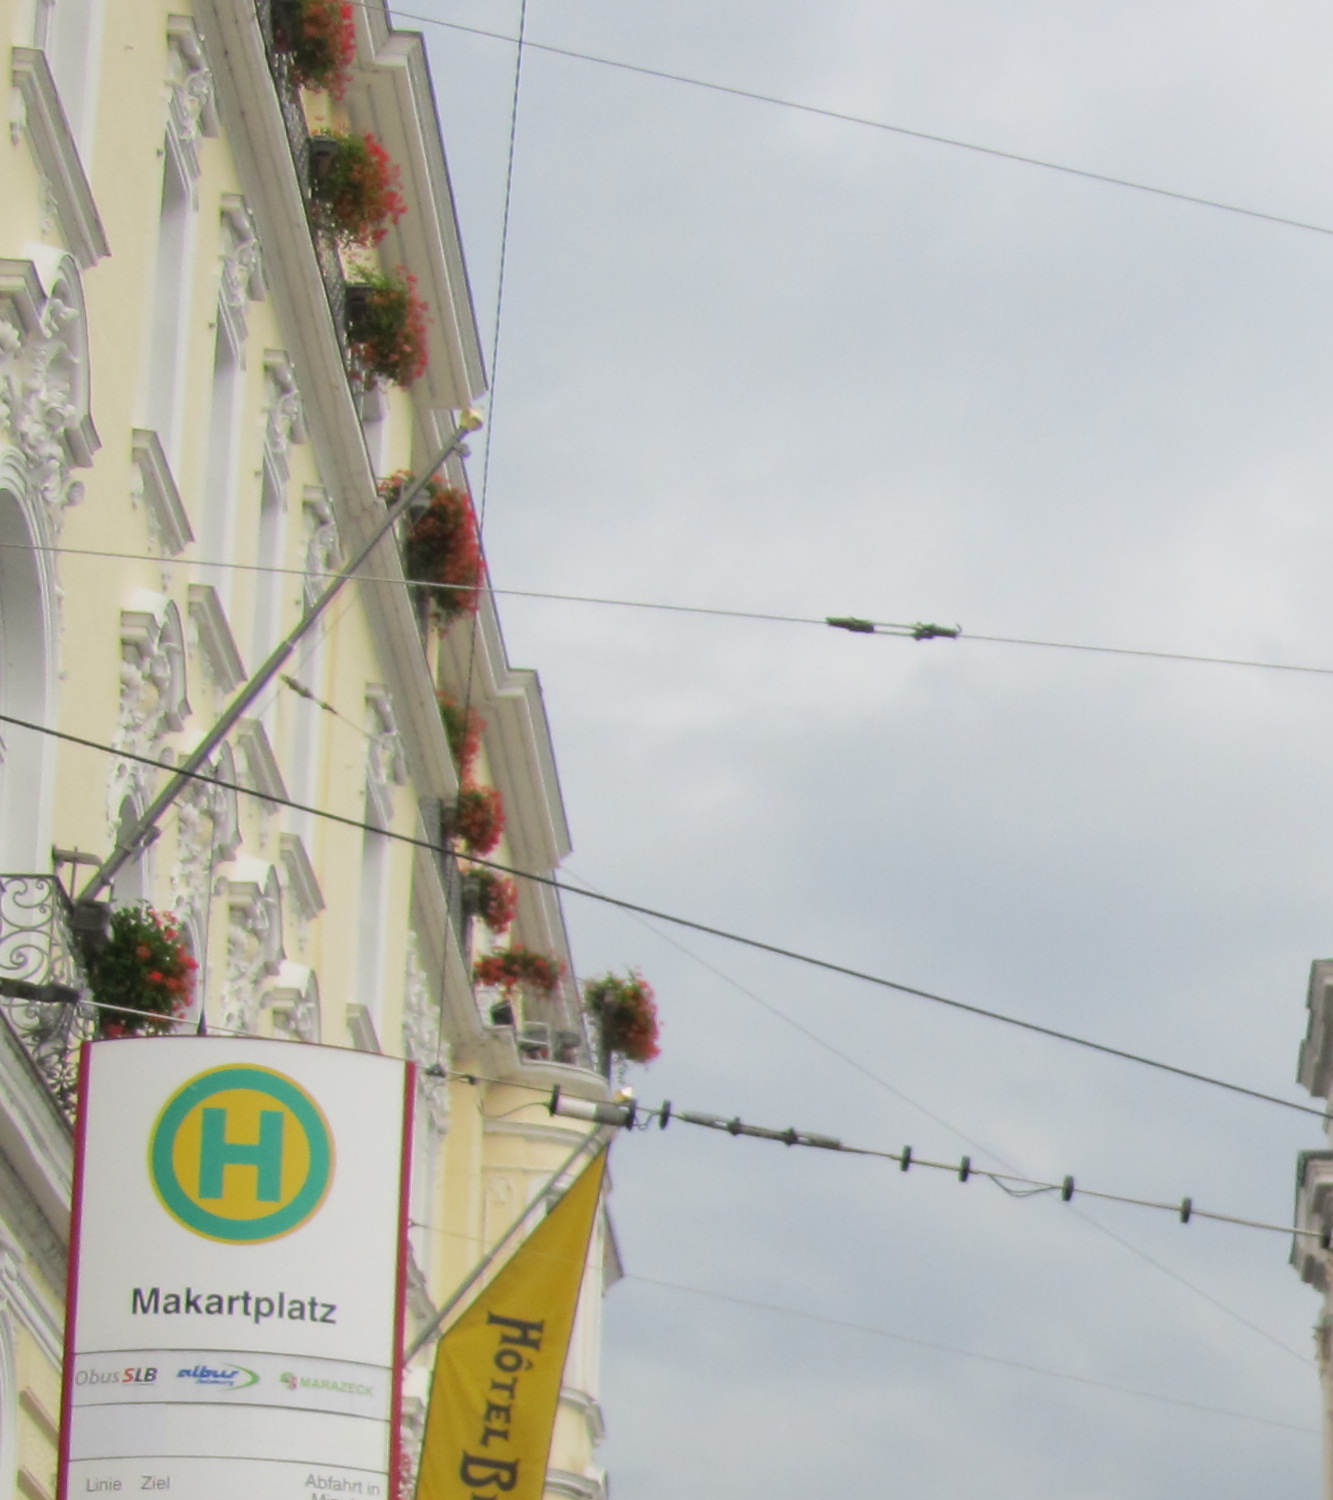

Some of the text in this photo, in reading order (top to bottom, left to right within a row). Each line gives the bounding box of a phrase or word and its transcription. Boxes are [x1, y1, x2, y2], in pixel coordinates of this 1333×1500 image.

[197, 1106, 284, 1203] H
[131, 1286, 338, 1325] Makartplatz
[121, 1367, 158, 1383] SLB
[86, 1475, 171, 1492] Linie Ziel
[305, 1473, 380, 1496] Abfahrt in
